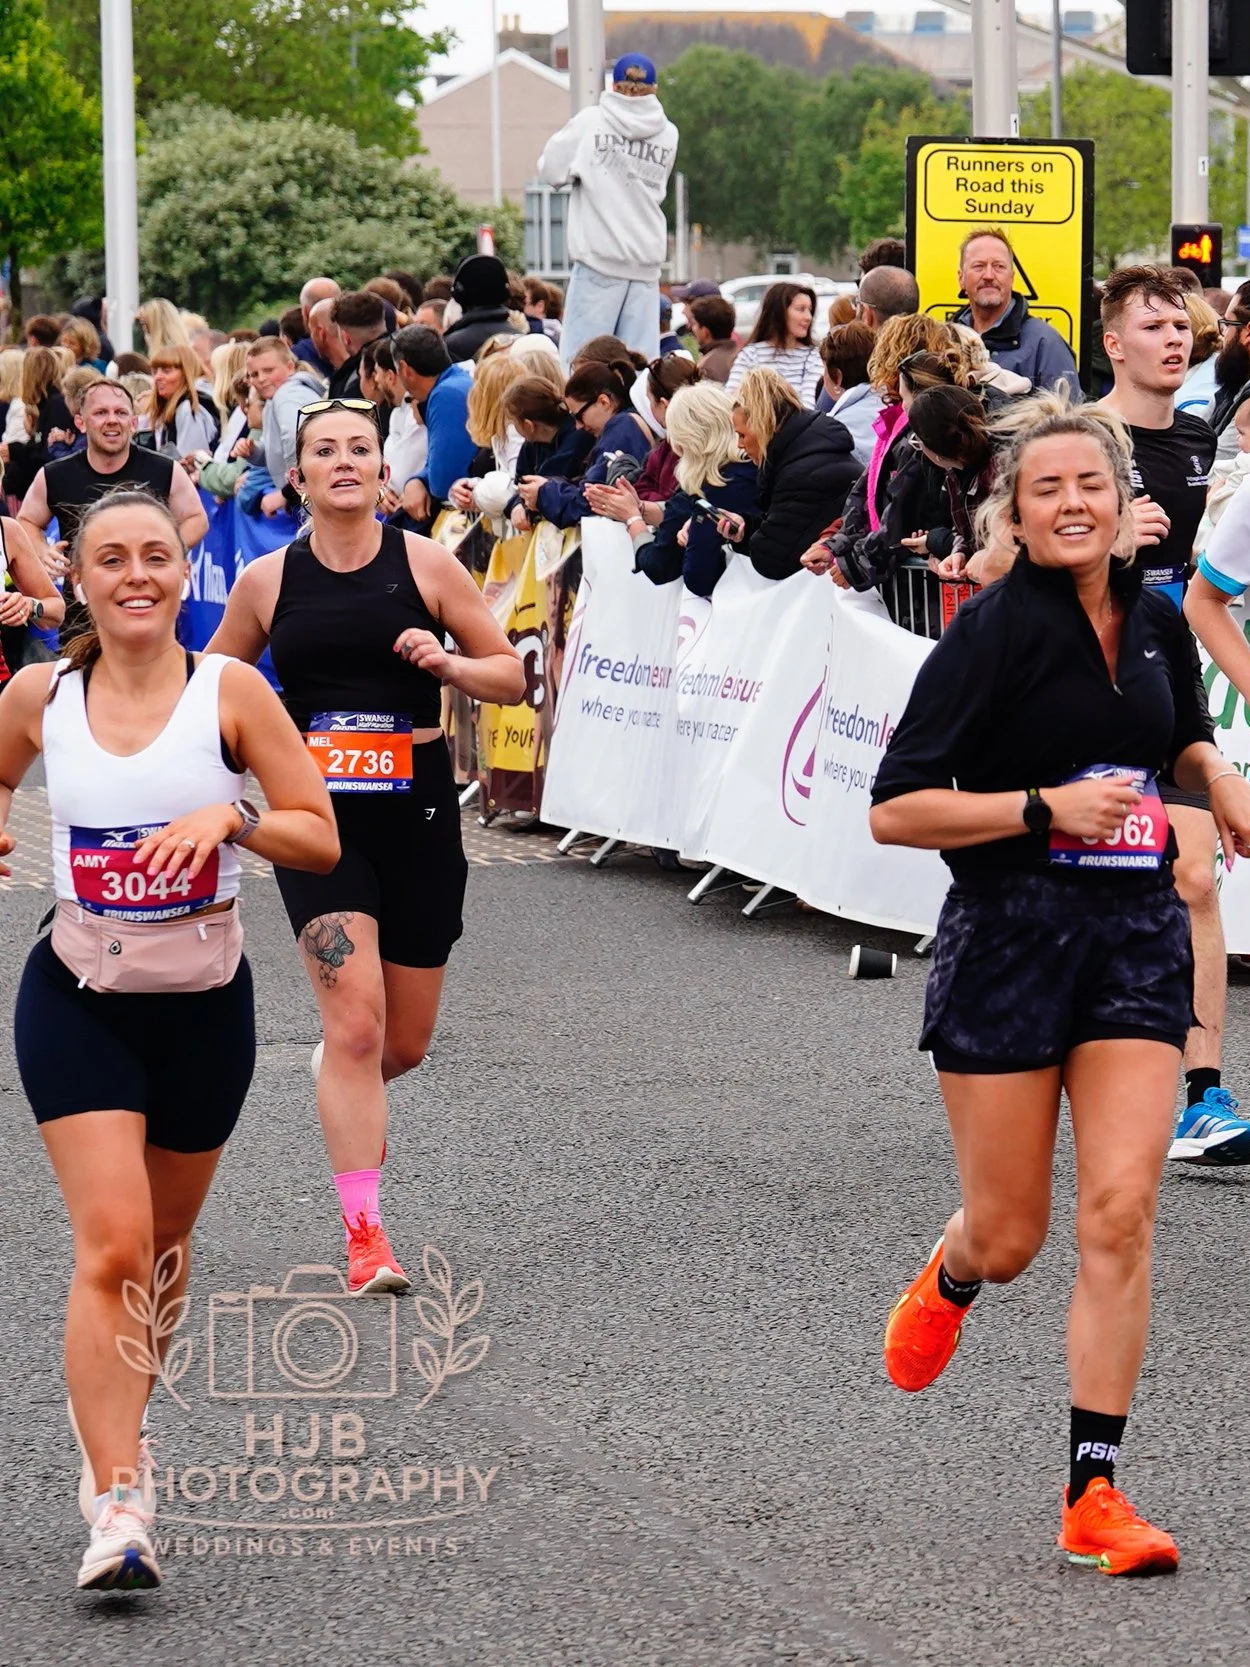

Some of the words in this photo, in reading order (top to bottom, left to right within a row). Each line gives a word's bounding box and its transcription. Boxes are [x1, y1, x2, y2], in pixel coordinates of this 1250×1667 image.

[946, 156, 1024, 173] Runners
[1031, 161, 1053, 173] on
[956, 177, 1004, 193] Road
[1011, 179, 1044, 193] this
[965, 198, 1034, 217] Sunday
[359, 714, 394, 722] SWANSEA
[309, 736, 334, 748] MEL
[504, 725, 535, 748] YOUR
[327, 749, 395, 775] 2736
[326, 780, 394, 791] #RUNSWANSEA
[846, 767, 868, 793] you
[1081, 813, 1157, 846] 62
[73, 854, 110, 868] AMY
[1078, 855, 1159, 868] #RUNSWANSEA
[101, 868, 192, 901] 3044
[103, 906, 191, 922] #RUNSWANSEA
[1076, 1441, 1120, 1462] PSR
